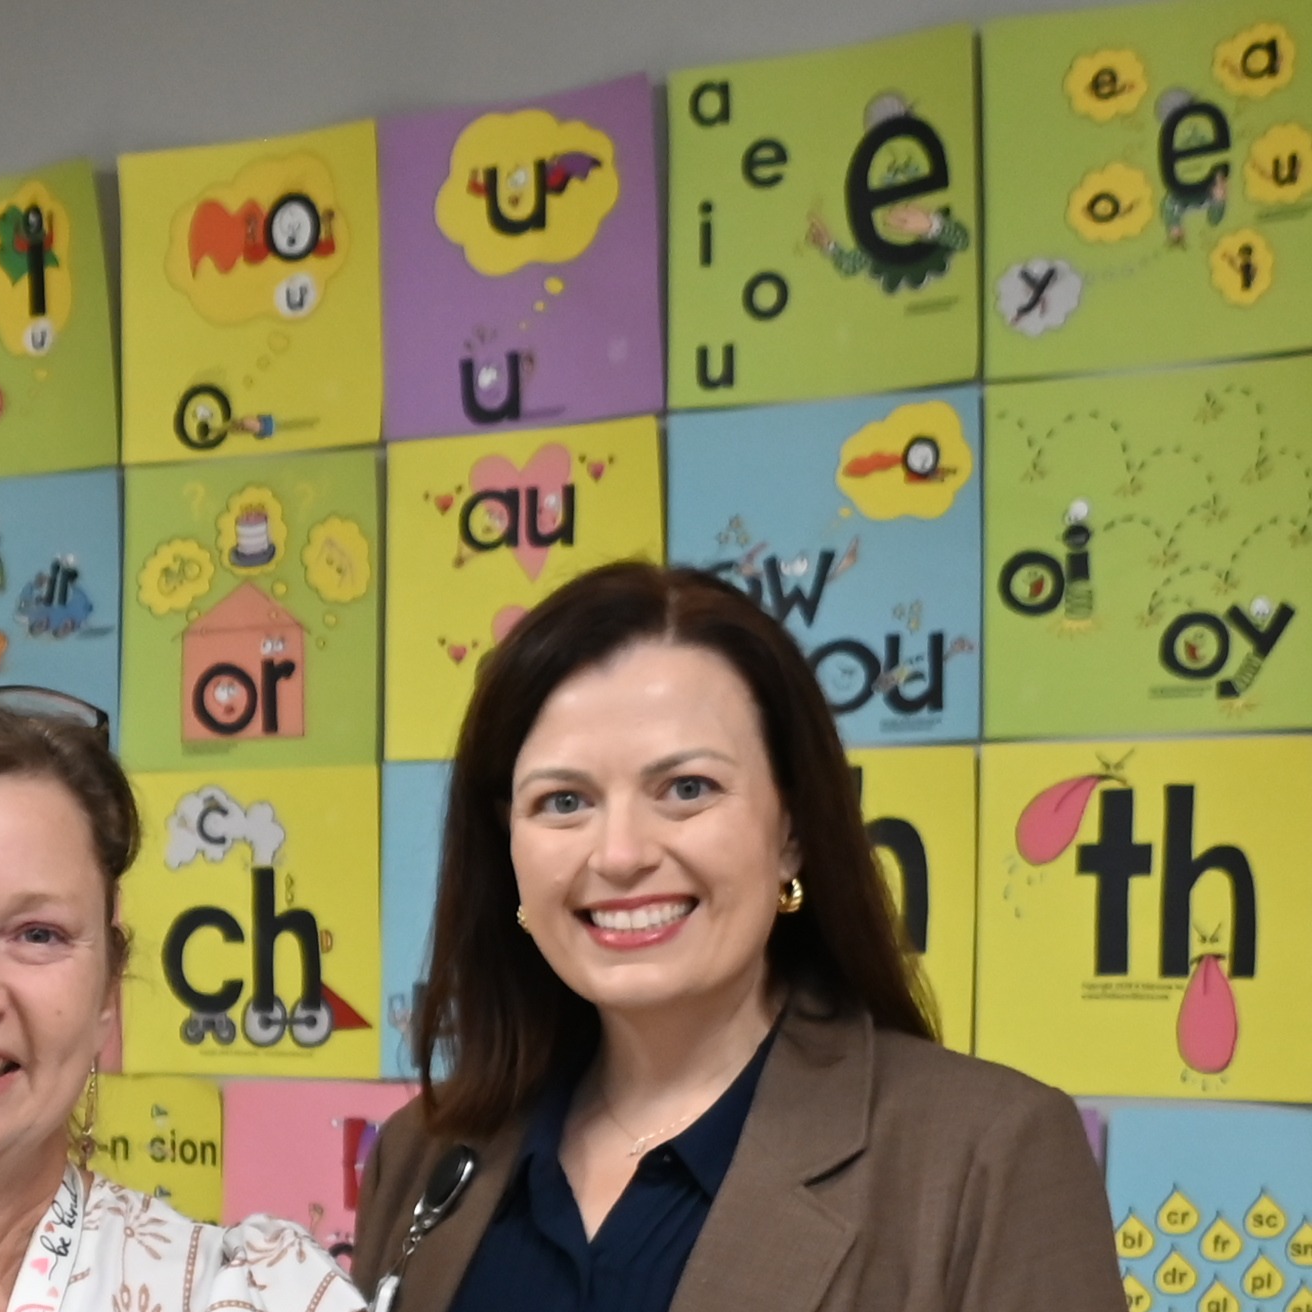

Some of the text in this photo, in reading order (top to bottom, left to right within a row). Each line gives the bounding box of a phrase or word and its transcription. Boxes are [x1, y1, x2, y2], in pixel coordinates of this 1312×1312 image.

[1241, 39, 1280, 79] a
[689, 80, 731, 128] a
[742, 138, 789, 188] e
[1158, 102, 1231, 204] e
[1273, 153, 1299, 187] u
[484, 159, 547, 235] u
[844, 115, 949, 265] e
[1087, 193, 1121, 223] o
[264, 193, 320, 262] o
[698, 201, 713, 267] i
[286, 287, 308, 311] u
[742, 271, 789, 320] o
[459, 351, 521, 424] u
[696, 343, 735, 389] u
[174, 383, 231, 450] o
[460, 483, 575, 550] au
[998, 524, 1093, 620] oi
[1158, 601, 1296, 701] oy
[192, 657, 295, 735] or
[197, 805, 228, 845] c
[1076, 784, 1257, 979] th
[161, 866, 322, 1014] ch
[1122, 1232, 1144, 1249] bl
[1167, 1210, 1189, 1225] cr
[1252, 1214, 1277, 1228] sc
[1213, 1235, 1230, 1252] fr
[1163, 1268, 1188, 1285] dr
[1251, 1272, 1272, 1294] pl
